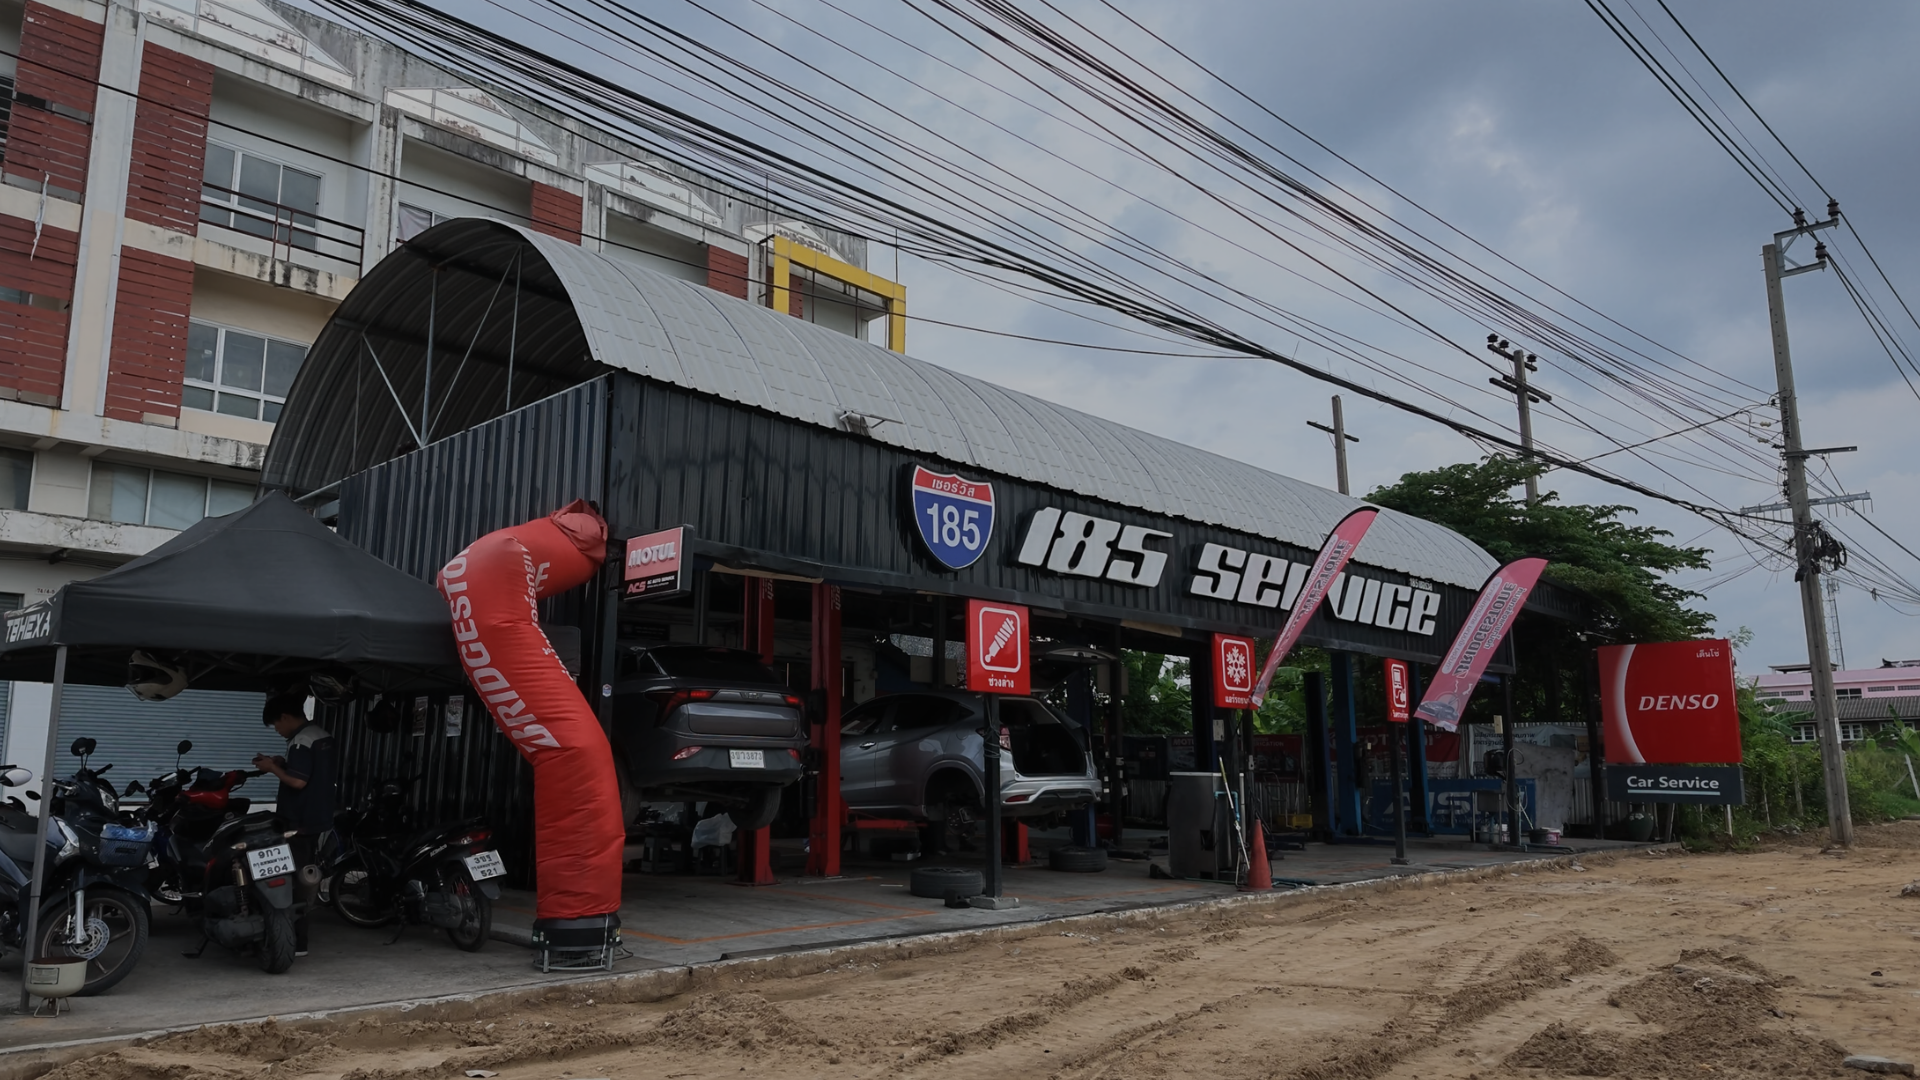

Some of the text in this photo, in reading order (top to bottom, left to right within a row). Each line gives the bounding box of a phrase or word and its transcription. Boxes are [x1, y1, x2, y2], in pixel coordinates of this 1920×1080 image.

[926, 502, 981, 551] 185
[628, 541, 677, 568] MOTUL
[1018, 506, 1173, 588] 185
[626, 580, 646, 595] ACS
[988, 673, 1015, 689] ช่วงล่าง
[1638, 693, 1719, 711] DENSO
[1626, 776, 1719, 789] Car Service
[258, 848, 281, 859] 9กว
[259, 864, 288, 877] 2804
[480, 868, 498, 877] 521
